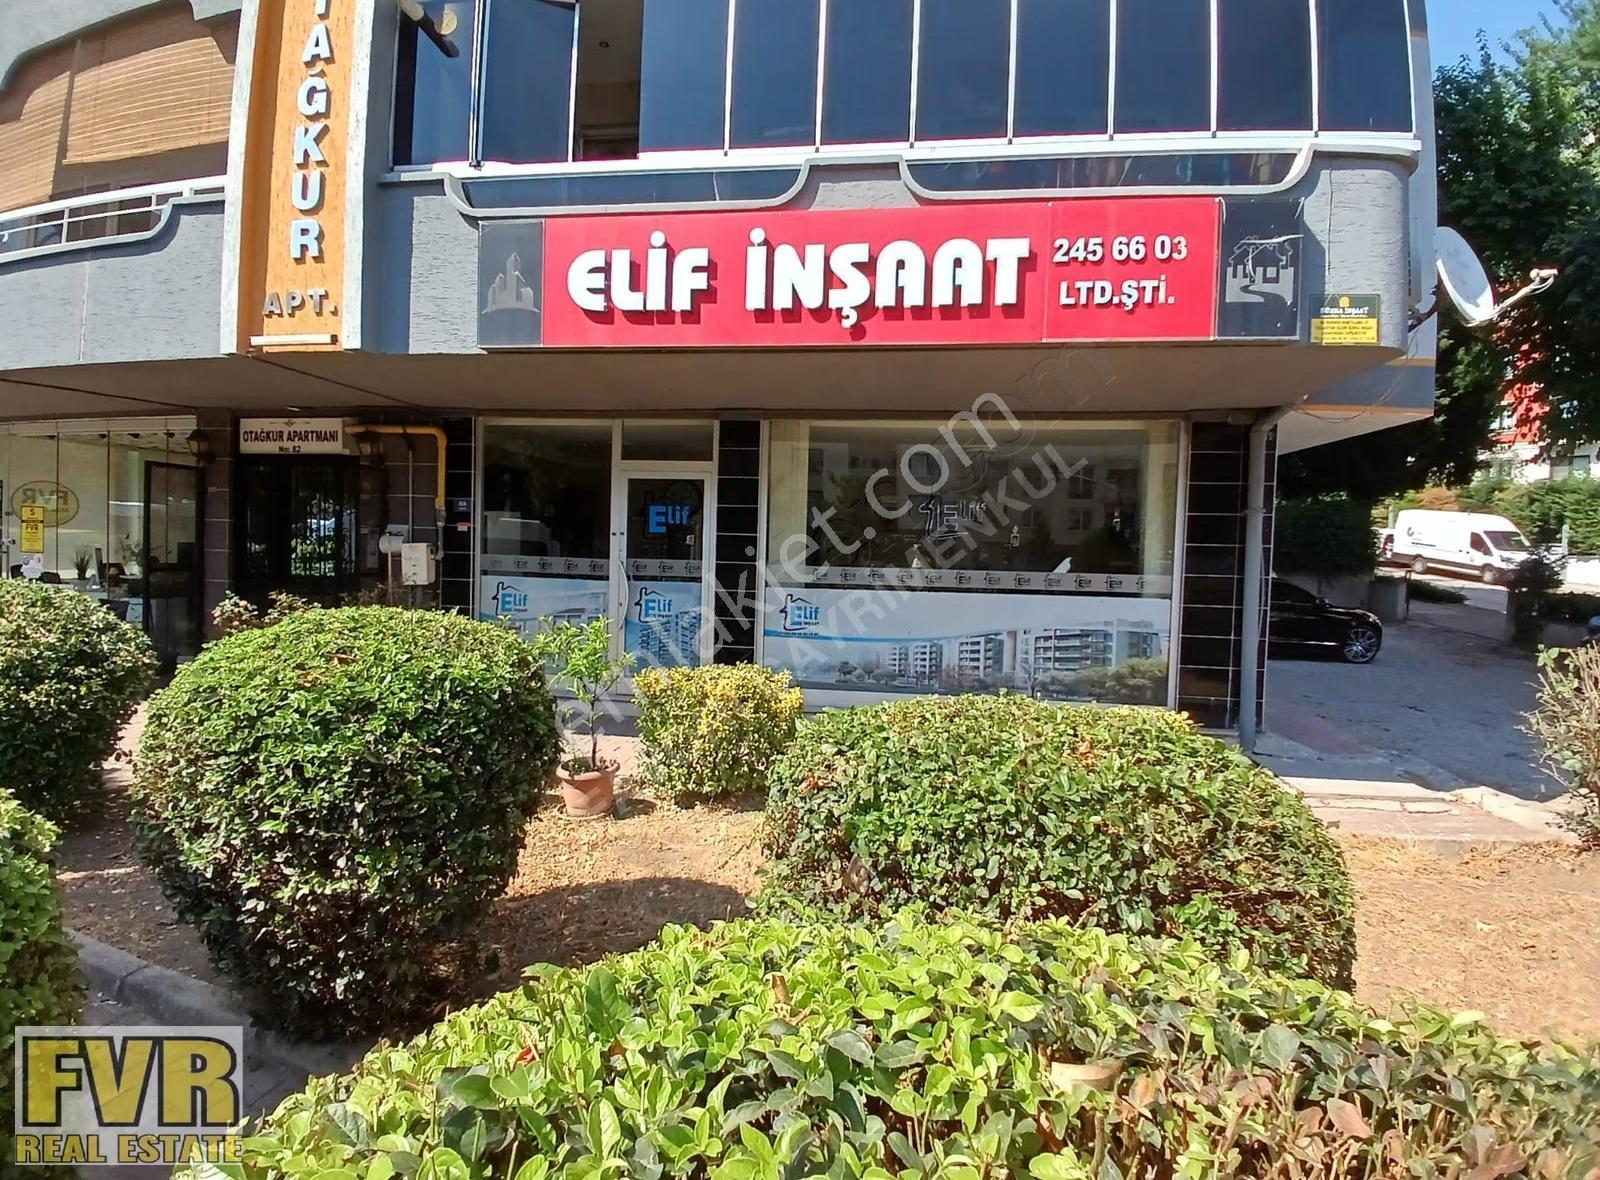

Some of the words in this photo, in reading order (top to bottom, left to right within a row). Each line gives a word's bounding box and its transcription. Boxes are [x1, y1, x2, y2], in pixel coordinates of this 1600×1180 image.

[1053, 237, 1103, 262] 245
[1112, 235, 1146, 261] 66
[1154, 235, 1188, 260] 03
[567, 230, 709, 312] ELİF
[746, 227, 1031, 329] İNŞAAT
[263, 289, 338, 316] APT.
[1059, 274, 1175, 310] LTD.ŞTİ.
[243, 427, 284, 442] OTAĞKUR
[287, 430, 338, 442] APARTMANI
[649, 505, 690, 533] Elif
[502, 592, 528, 612] Elif
[645, 599, 673, 618] Elif
[789, 606, 820, 626] Elif
